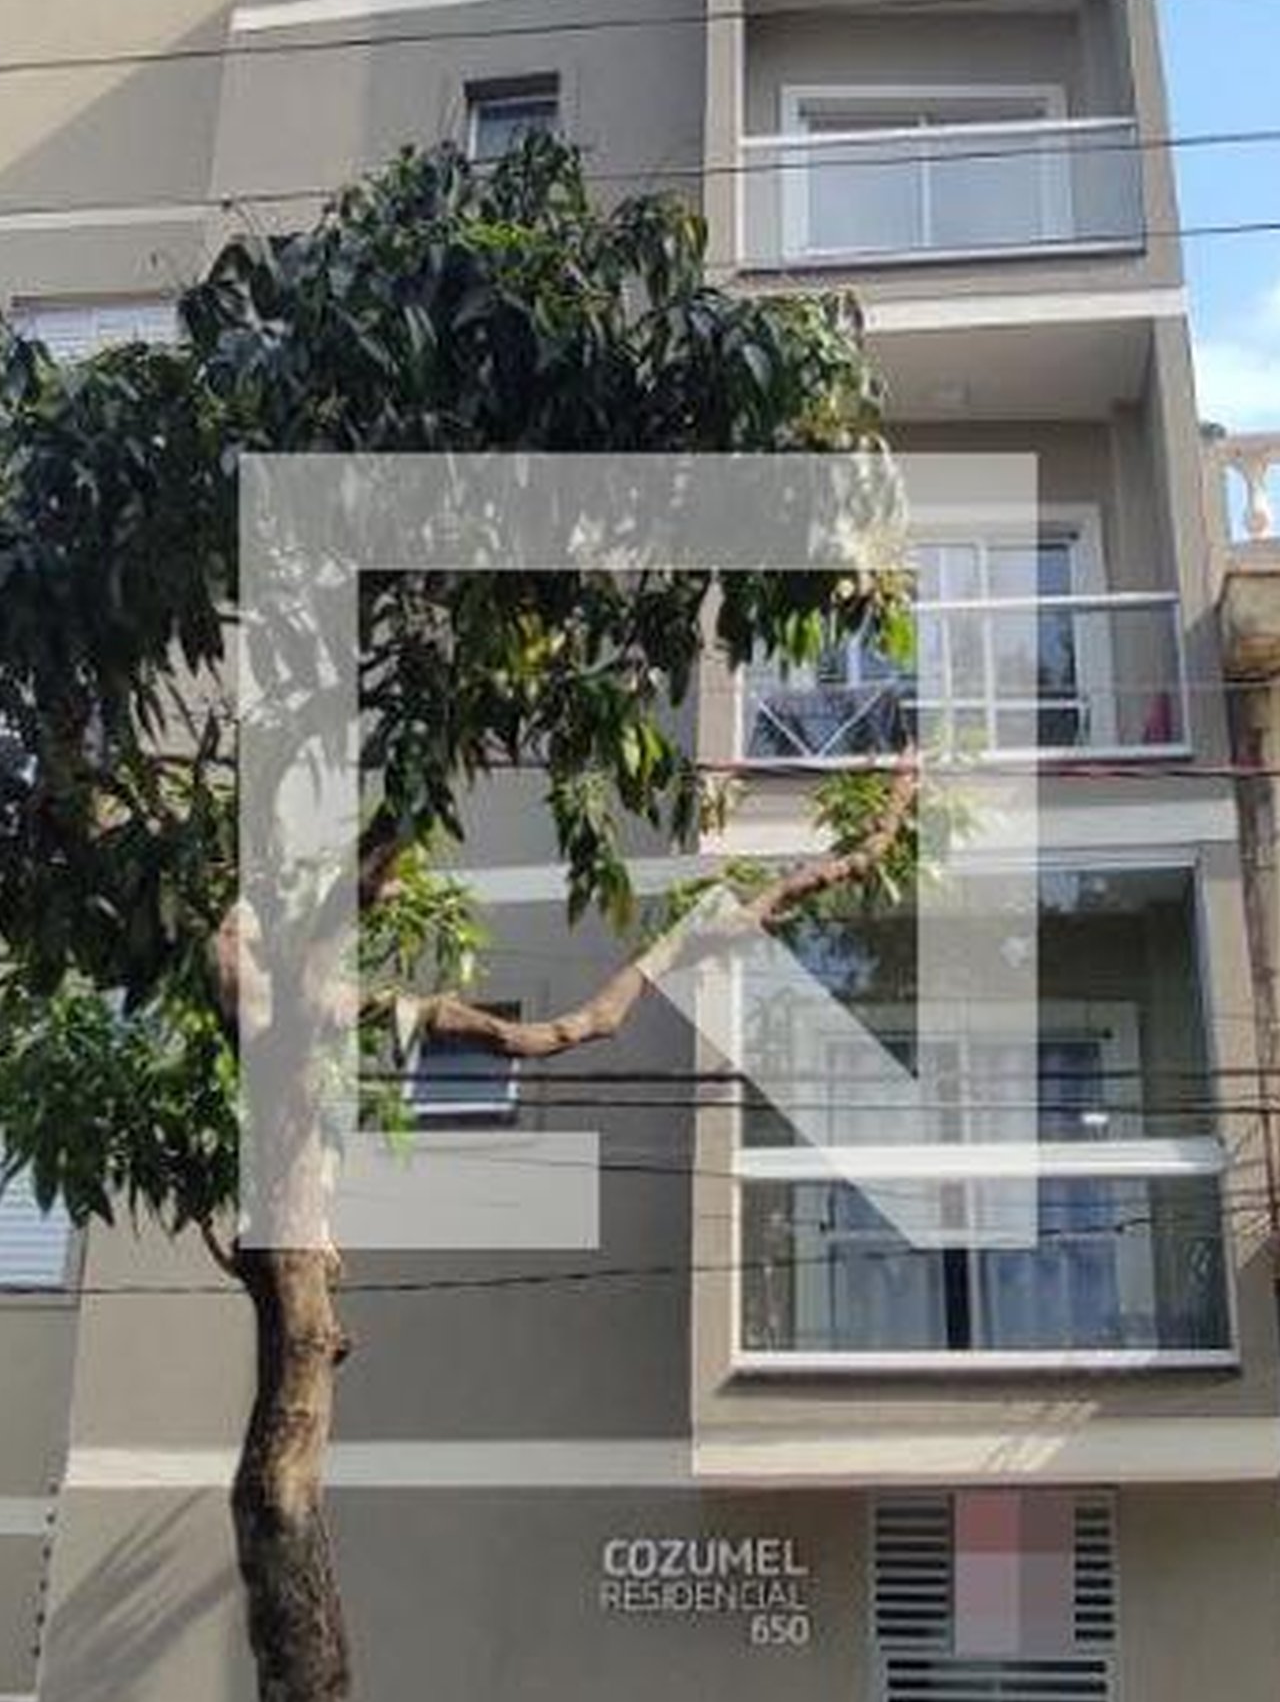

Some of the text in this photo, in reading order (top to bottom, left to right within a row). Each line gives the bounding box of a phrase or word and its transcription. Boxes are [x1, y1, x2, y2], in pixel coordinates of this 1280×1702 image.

[603, 1538, 809, 1577] COZUMEL
[600, 1579, 808, 1611] RESIDENCIAL
[751, 1613, 810, 1645] 650
